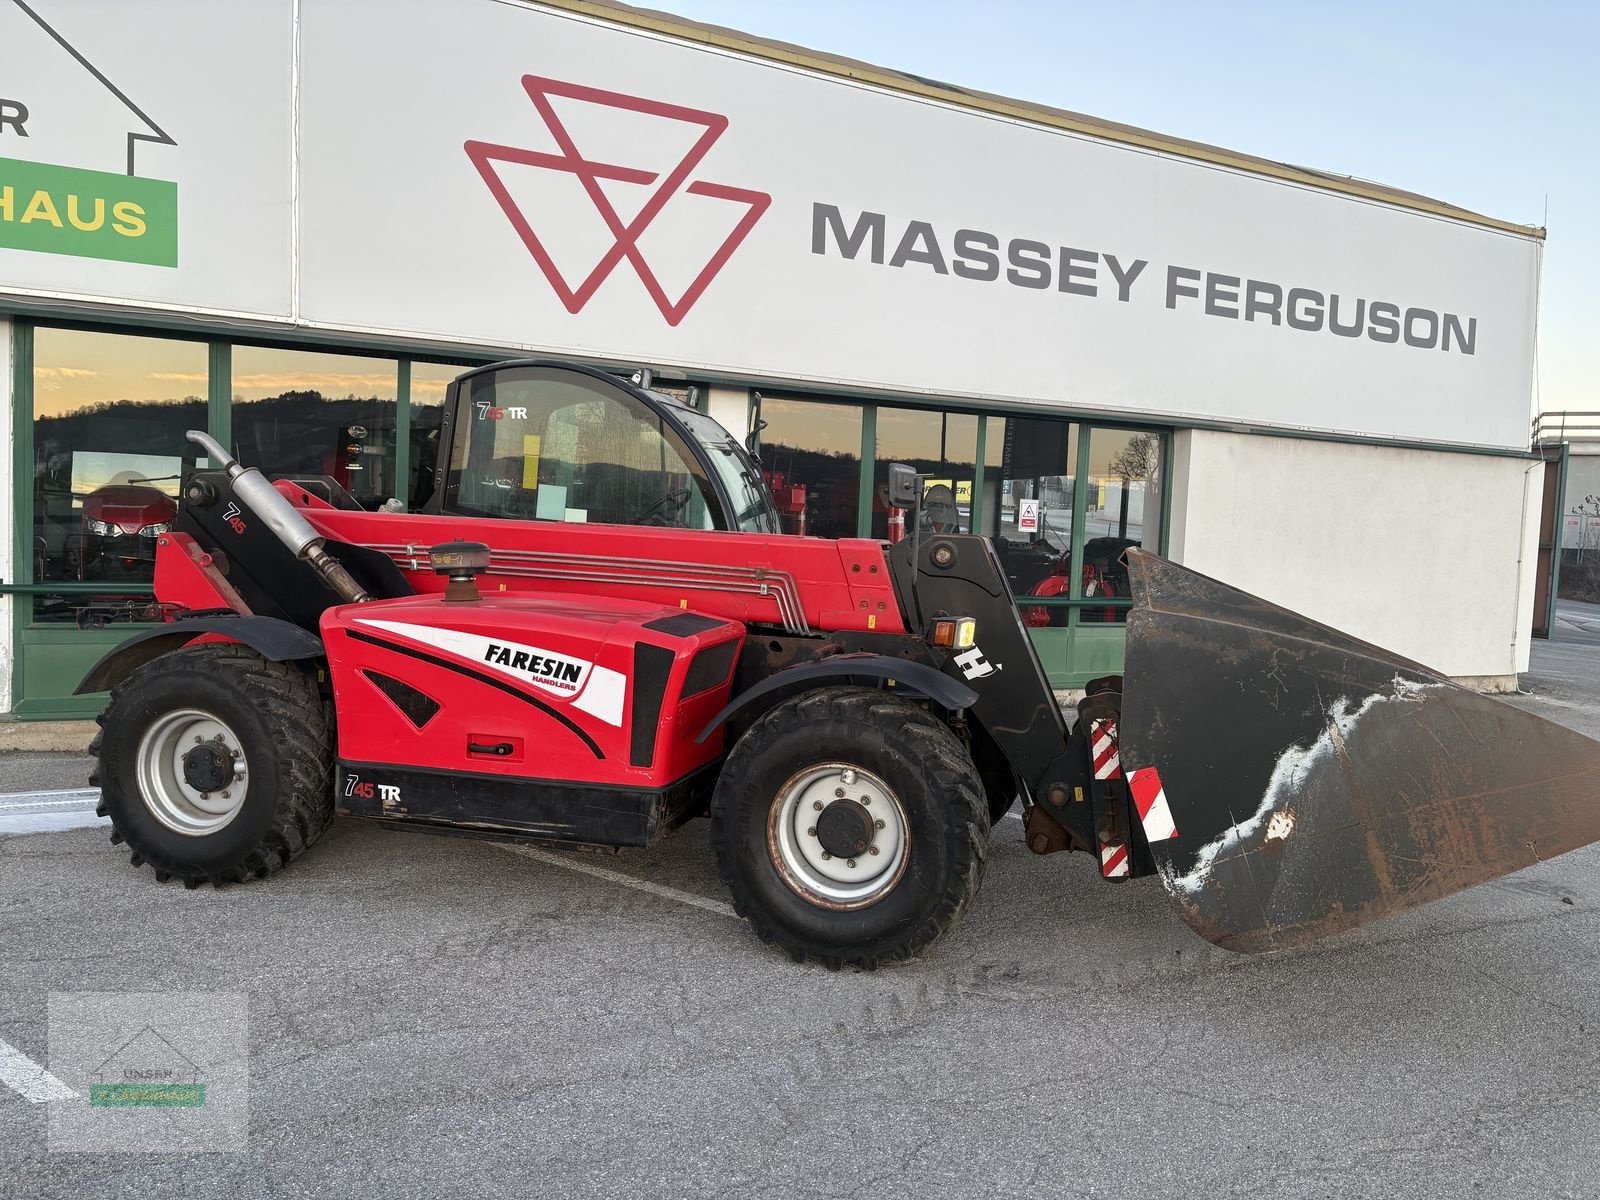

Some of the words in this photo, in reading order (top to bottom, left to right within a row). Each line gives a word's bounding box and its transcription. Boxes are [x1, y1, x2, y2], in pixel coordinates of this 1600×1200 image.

[811, 202, 1150, 303] MASSEY
[1165, 264, 1478, 356] FERGUSON
[476, 401, 504, 421] 745
[508, 406, 528, 420] TR
[222, 501, 248, 535] 745
[484, 643, 582, 684] FARESIN
[532, 675, 576, 692] HANDLERS
[344, 773, 375, 799] 745
[377, 784, 402, 802] TR
